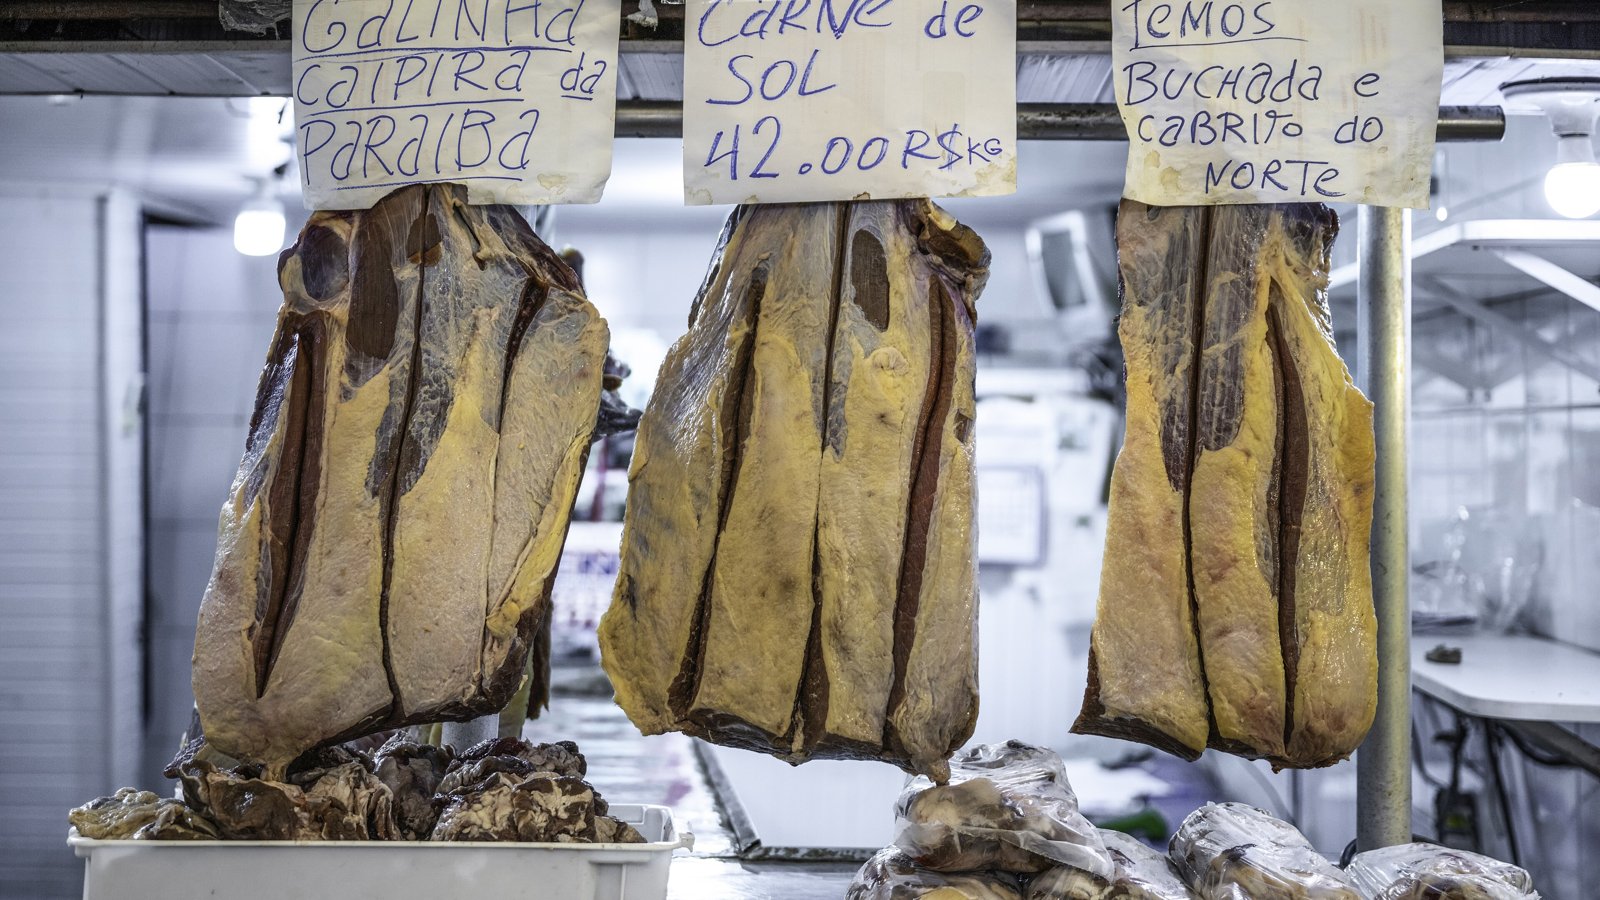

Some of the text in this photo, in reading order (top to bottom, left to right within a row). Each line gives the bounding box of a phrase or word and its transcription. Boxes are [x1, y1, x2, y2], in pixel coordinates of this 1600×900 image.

[302, 0, 584, 52] GaLINHa
[698, 0, 983, 46] CaRNe de
[1122, 0, 1275, 48] TeMOS
[297, 50, 606, 108] CaIPIRa da
[706, 49, 836, 105] SOL
[1123, 59, 1380, 105] BUCHada e
[300, 109, 539, 186] PaRaIBa
[704, 116, 889, 180] 42.00
[1334, 115, 1383, 144] do
[1205, 159, 1346, 197] NORTe
